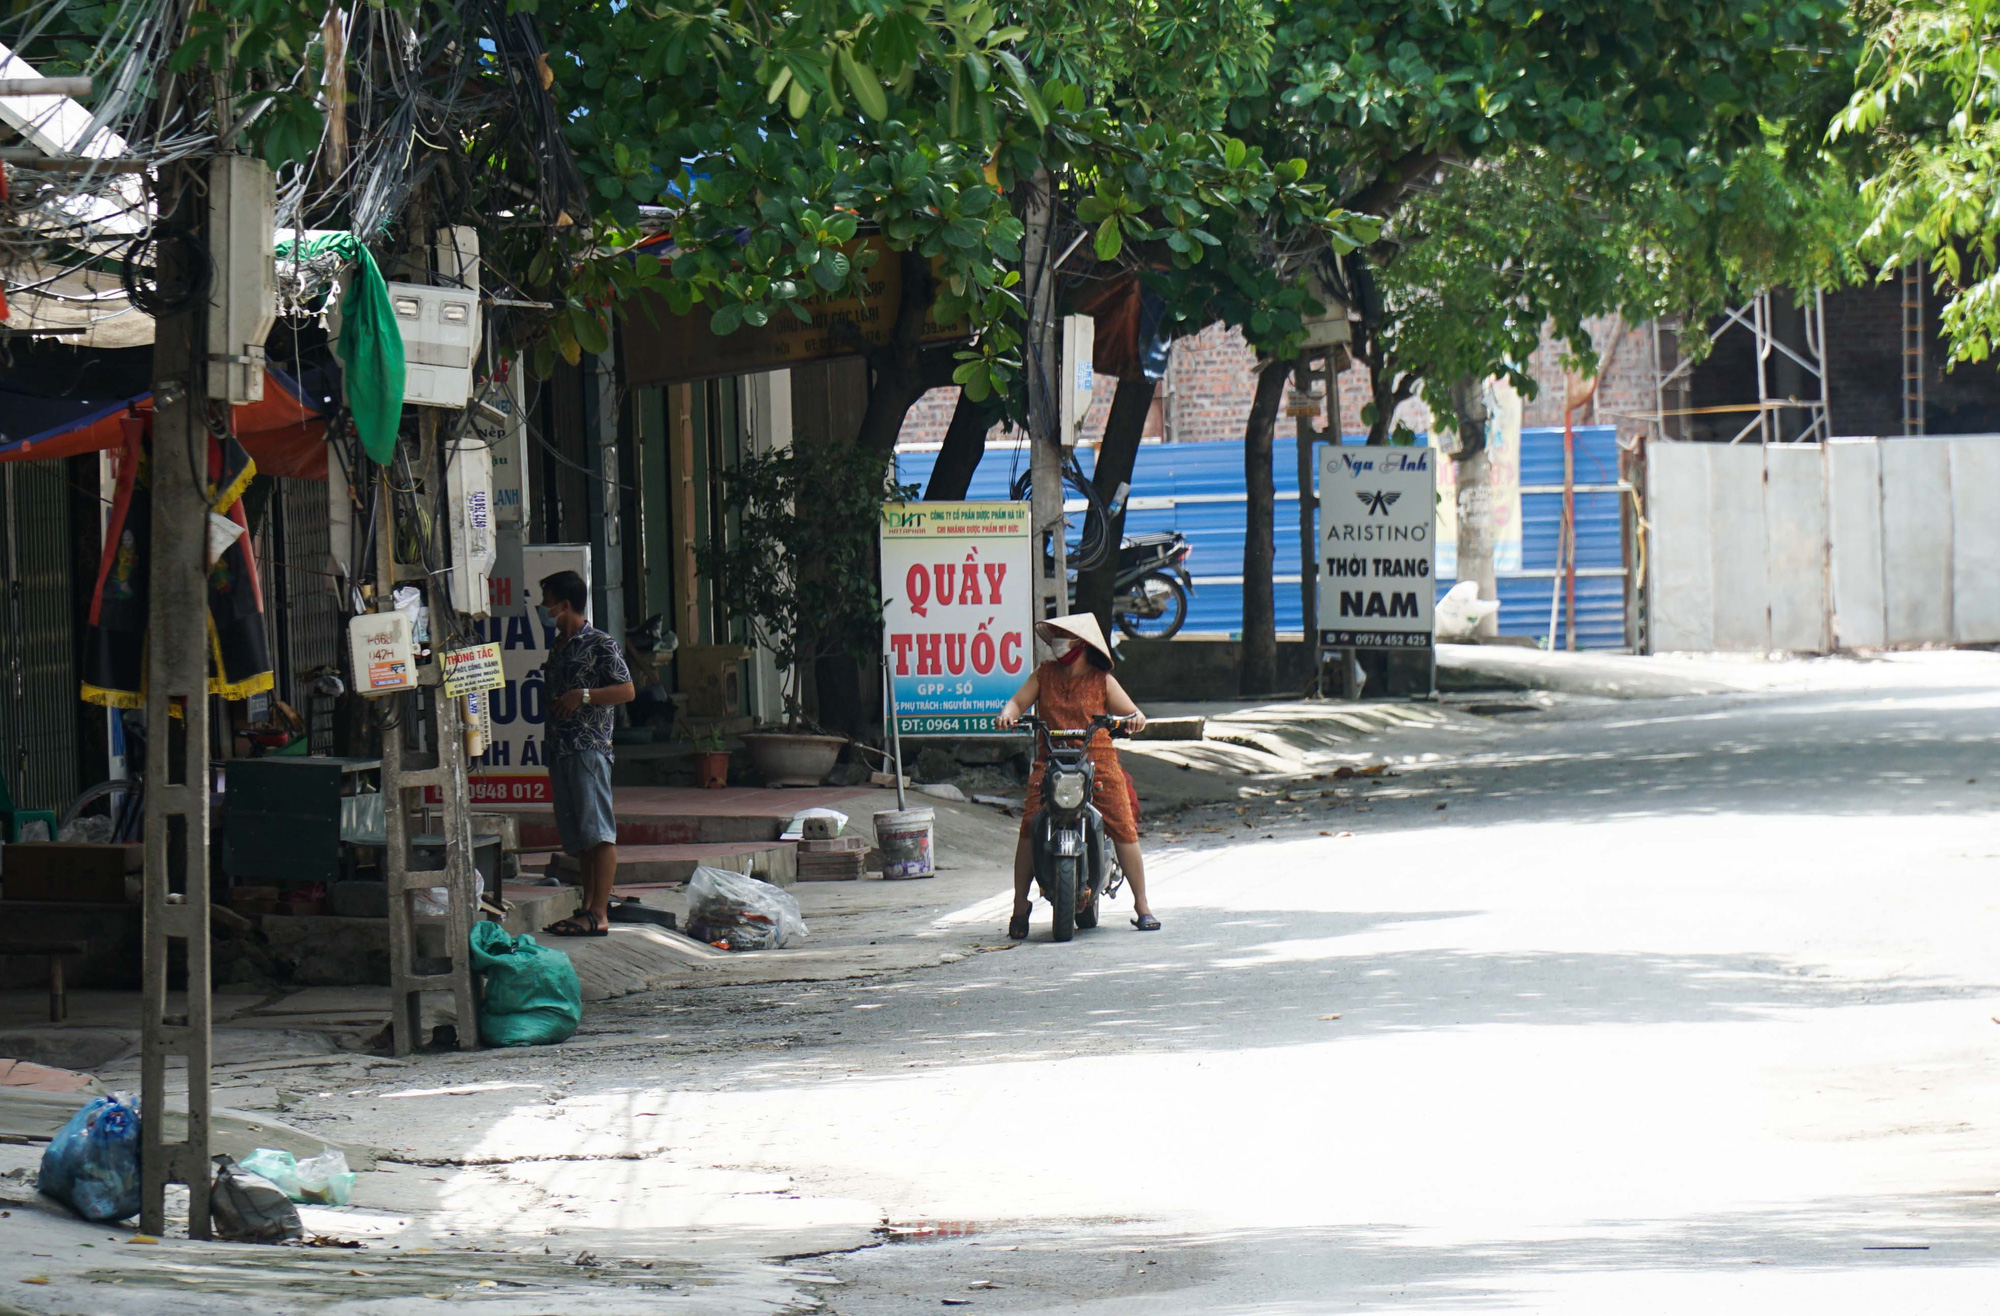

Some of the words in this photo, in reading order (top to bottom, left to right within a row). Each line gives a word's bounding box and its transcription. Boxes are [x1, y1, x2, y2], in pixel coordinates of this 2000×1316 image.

[1327, 453, 1373, 479] Nga
[1326, 553, 1367, 577] THỜI
[1372, 558, 1429, 577] TRANG
[906, 546, 1006, 618] QUẦY
[1340, 590, 1419, 618] NAM
[890, 617, 1023, 675] THUỐC
[1355, 634, 1382, 646] 0976
[1384, 634, 1404, 646] 452
[1406, 634, 1426, 646] 425
[917, 683, 945, 695] GPP
[956, 680, 973, 695] SỐ
[900, 701, 915, 712] PHỤ
[916, 699, 939, 710] TRÁCH
[943, 698, 972, 710] NGUYỄN
[973, 700, 985, 711] THỊ
[926, 719, 960, 731] 0964
[963, 718, 988, 730] 118
[512, 783, 545, 799] 012
